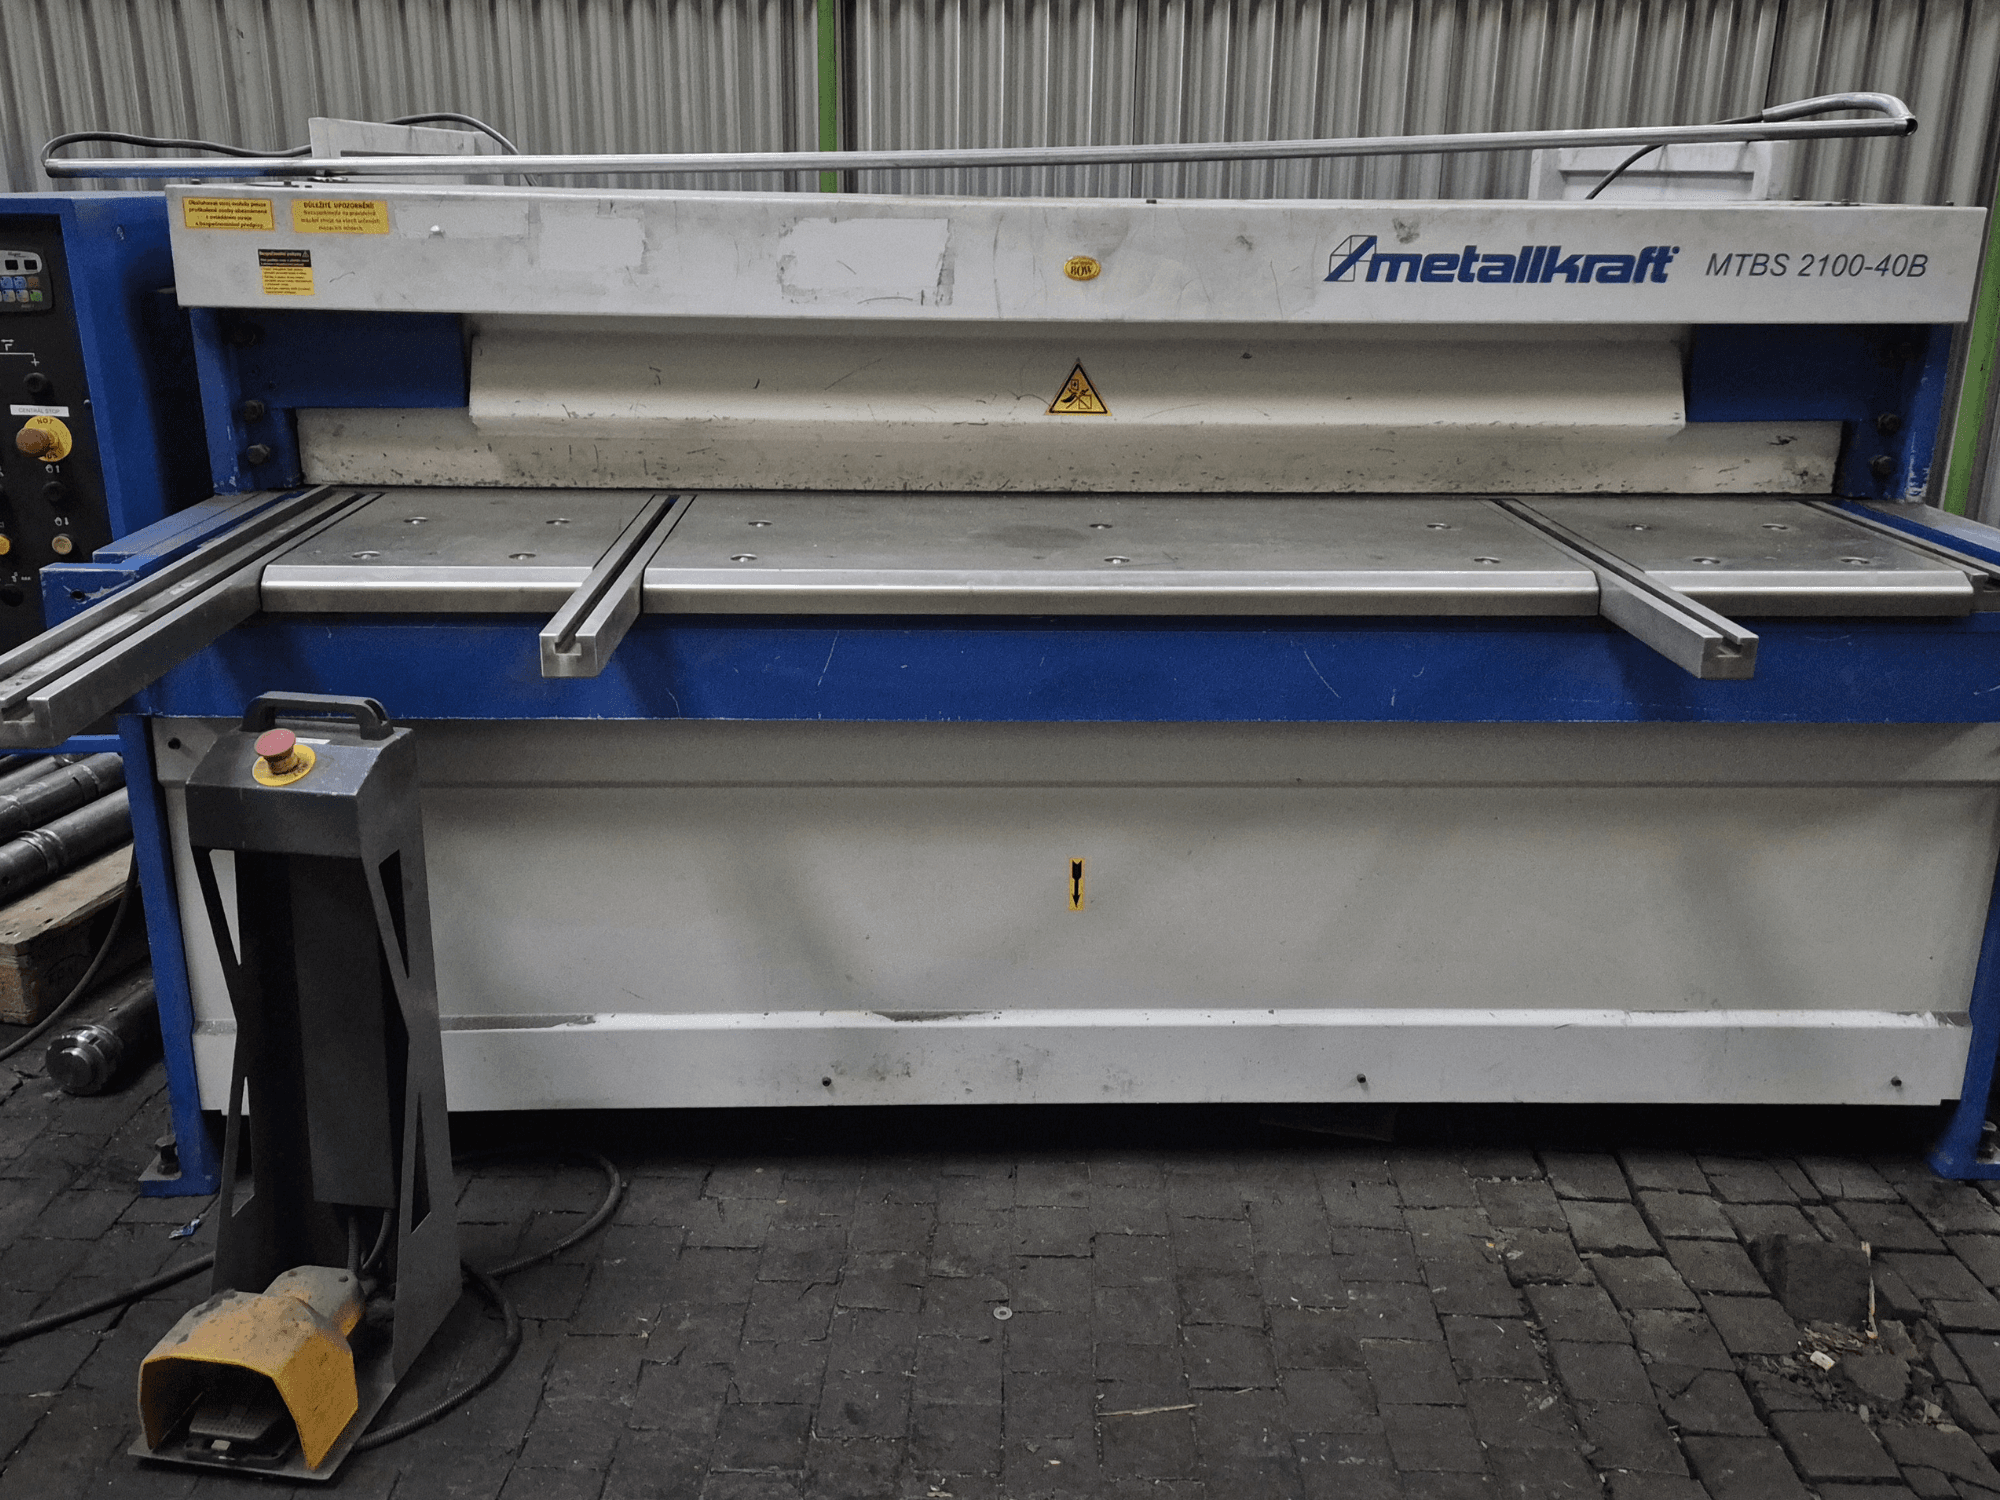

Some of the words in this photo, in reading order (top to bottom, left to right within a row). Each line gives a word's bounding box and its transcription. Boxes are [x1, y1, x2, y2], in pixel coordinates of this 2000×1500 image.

[1365, 244, 1681, 284] metallkraft
[1705, 252, 1790, 277] MTBS
[1797, 253, 1929, 278] 2100-40B
[36, 417, 55, 425] NOT
